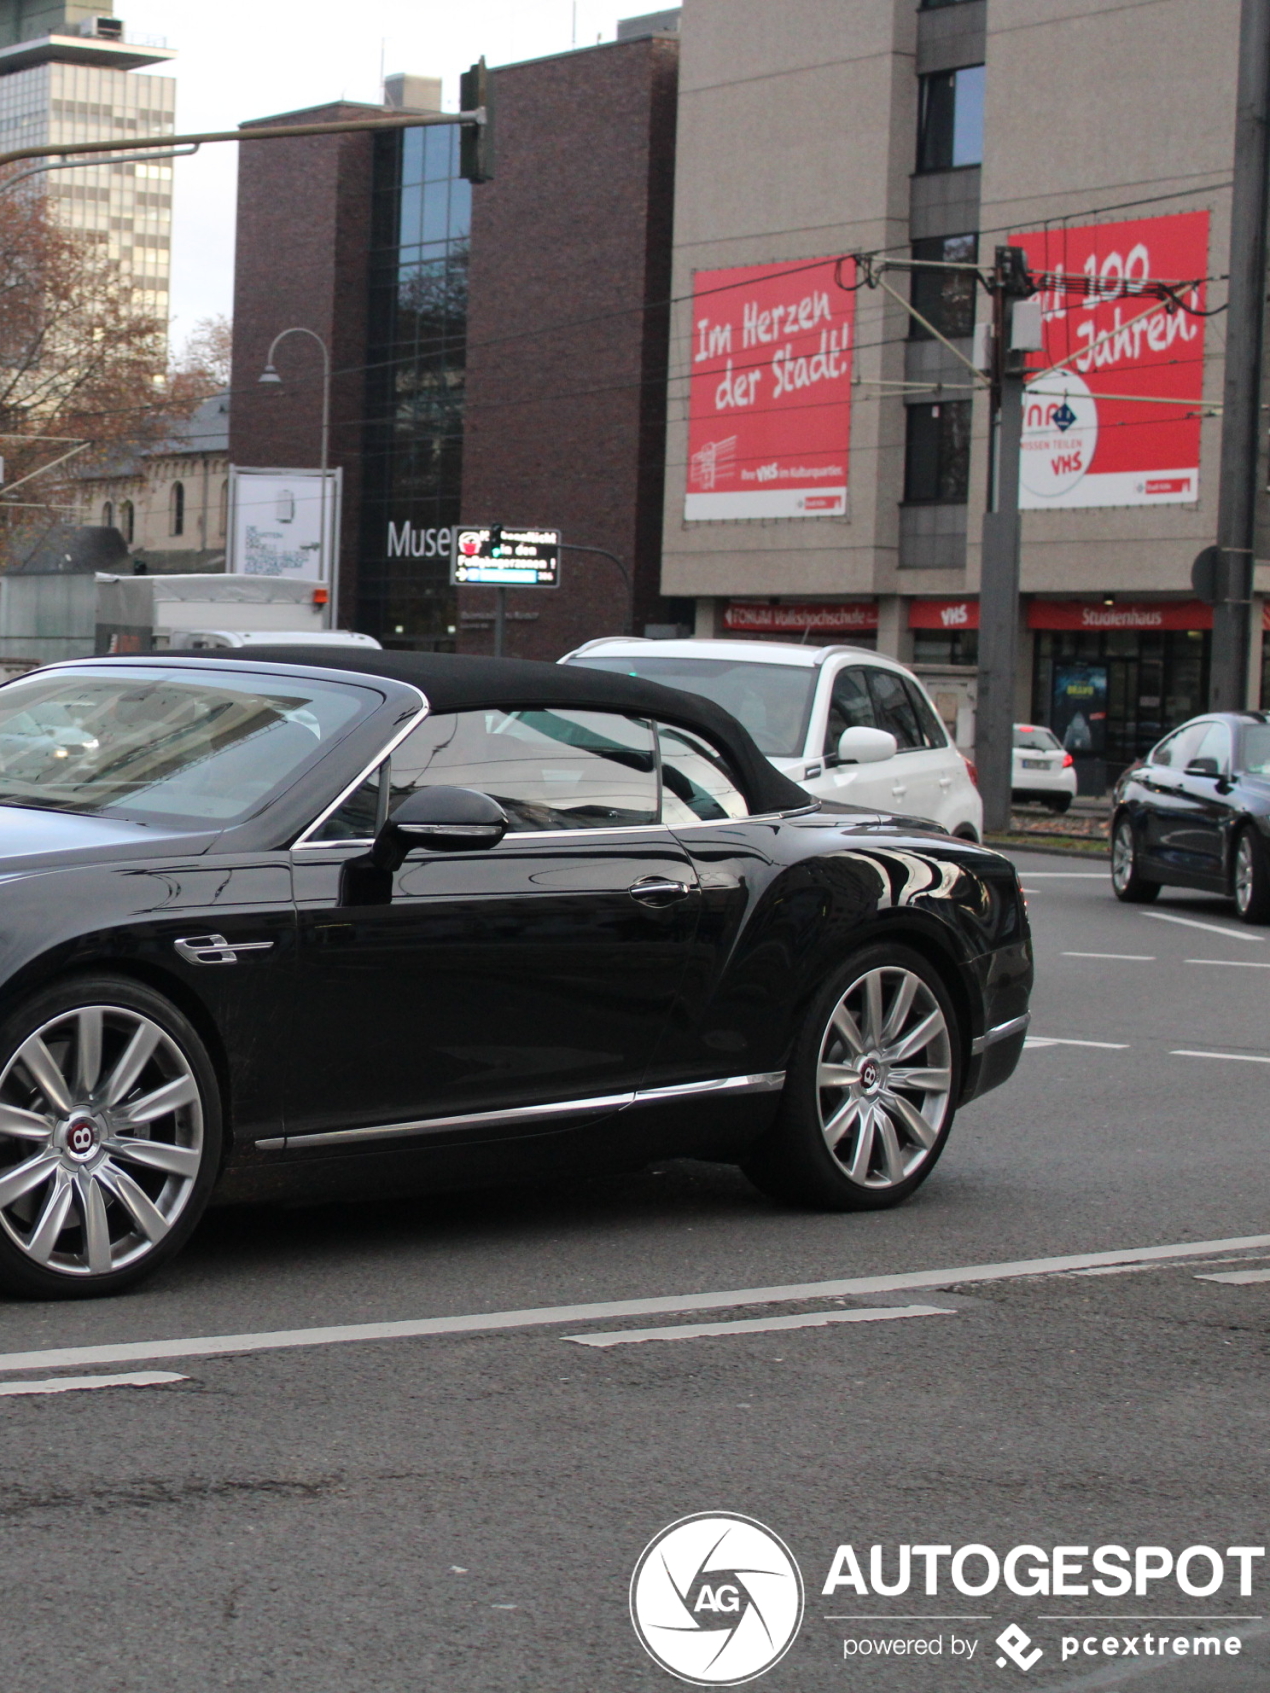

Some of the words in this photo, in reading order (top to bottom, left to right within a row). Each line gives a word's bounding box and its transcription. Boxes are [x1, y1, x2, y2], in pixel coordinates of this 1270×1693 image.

[1083, 243, 1149, 309] 100
[695, 318, 732, 362] Im
[743, 289, 832, 348] Herzen
[715, 358, 761, 410] der
[772, 322, 849, 399] Stadt!
[1053, 438, 1082, 449] TEILEN
[756, 462, 778, 482] VHS
[1051, 451, 1082, 476] VHS
[941, 604, 967, 626] VHS
[1082, 608, 1162, 626] Studienhaus
[73, 1127, 91, 1150] B
